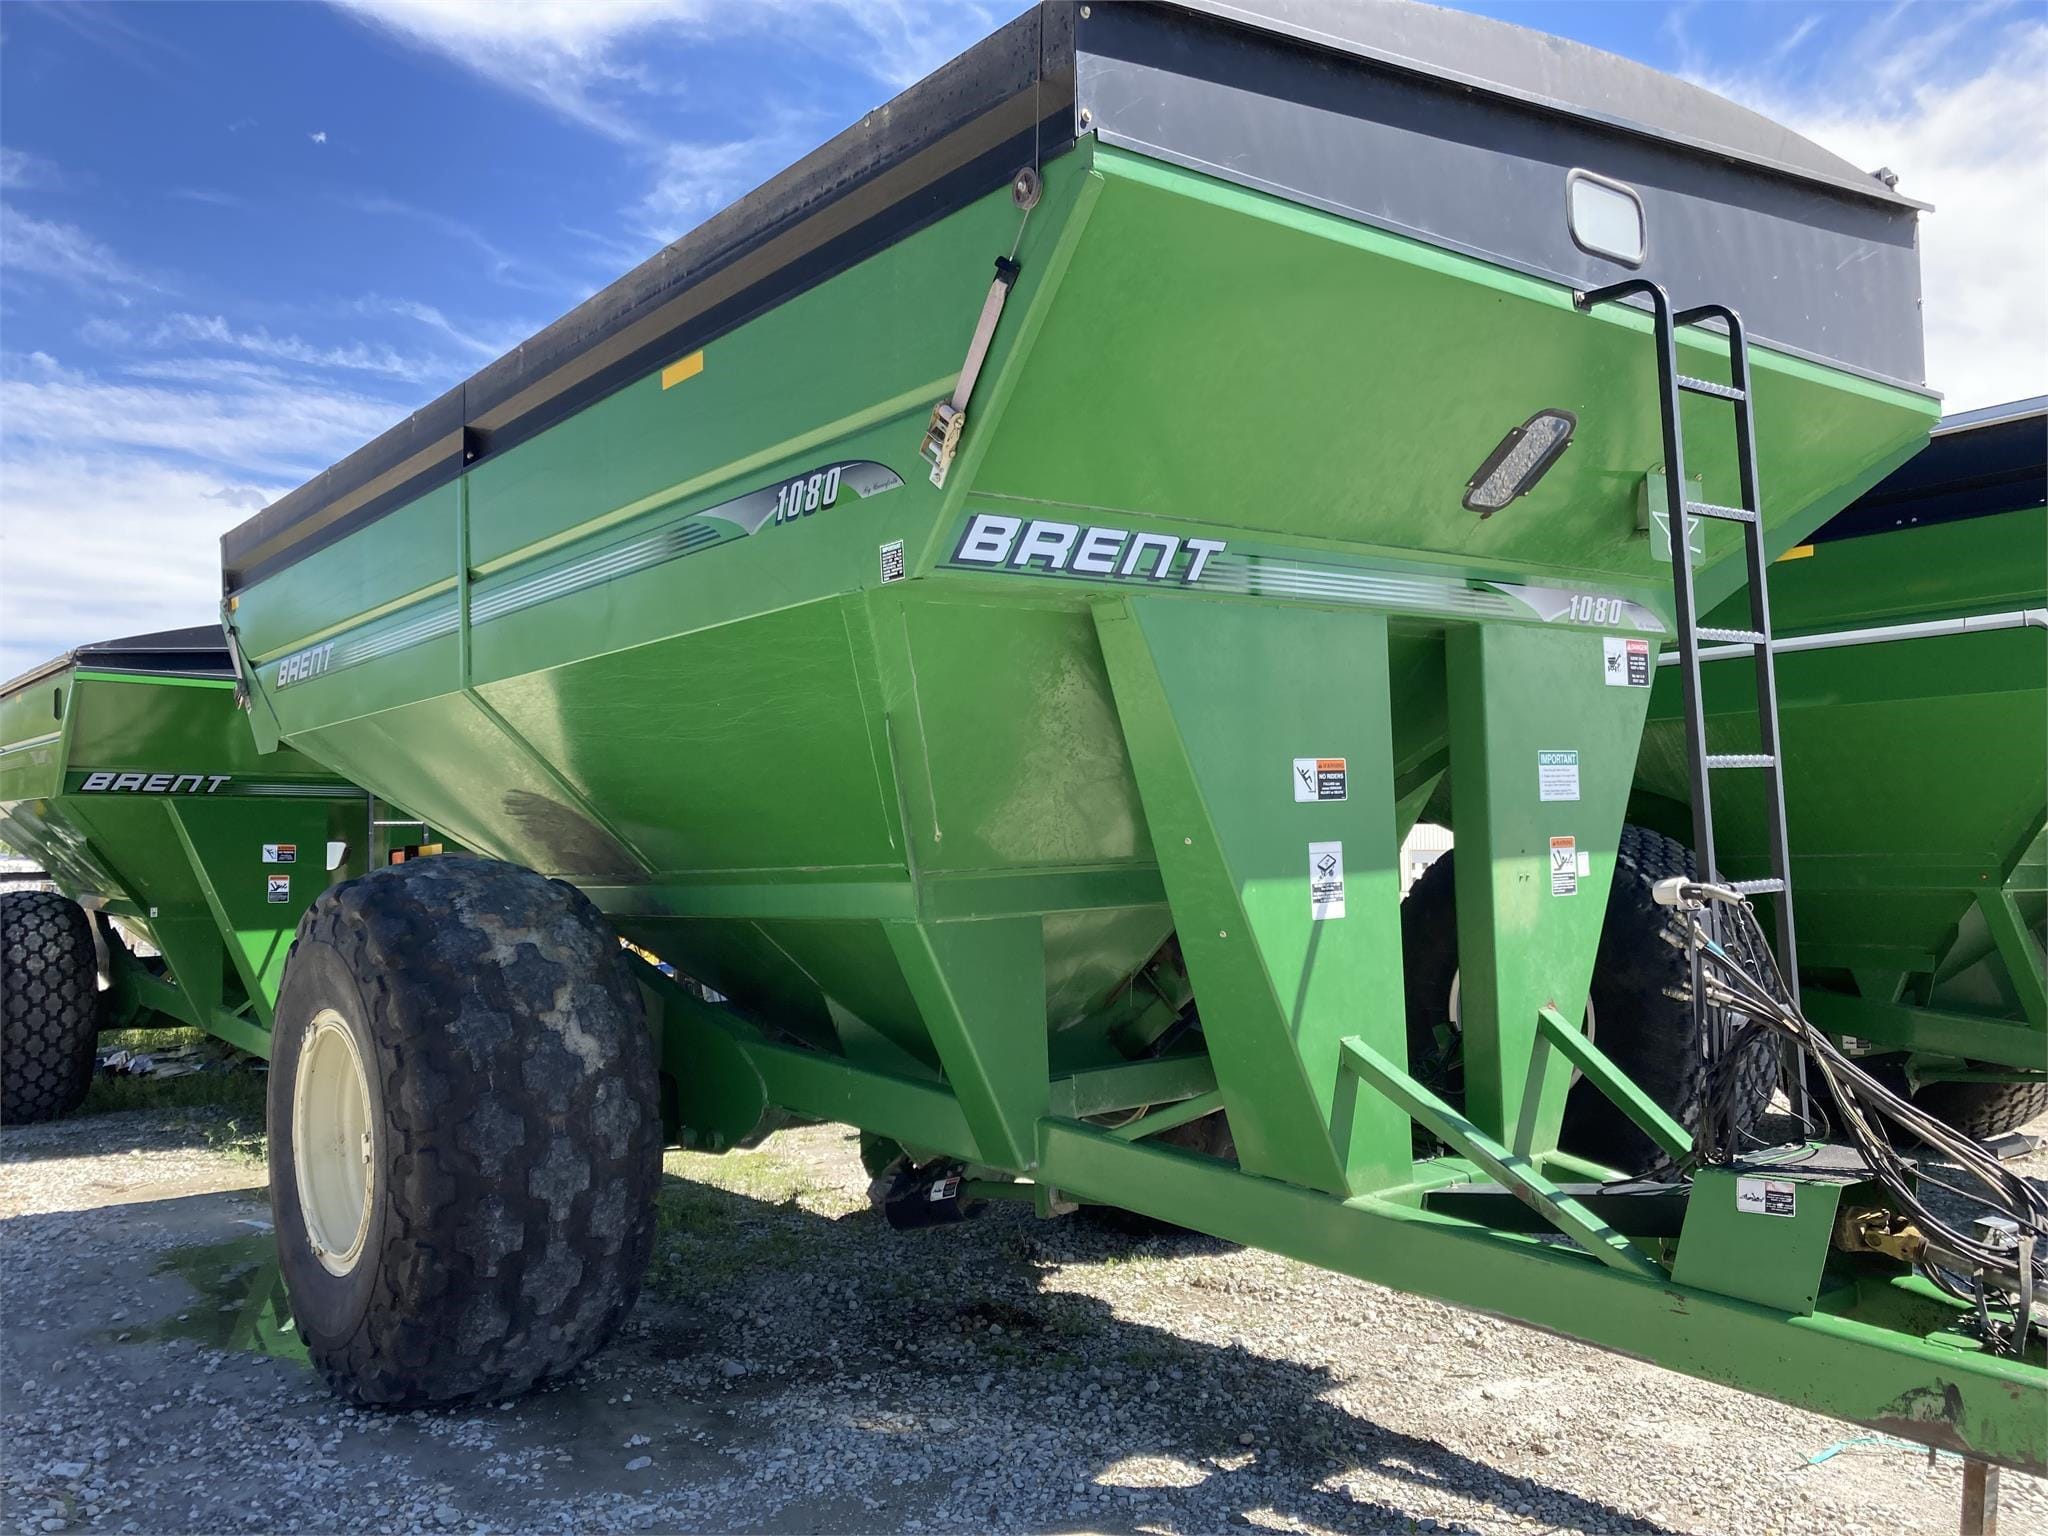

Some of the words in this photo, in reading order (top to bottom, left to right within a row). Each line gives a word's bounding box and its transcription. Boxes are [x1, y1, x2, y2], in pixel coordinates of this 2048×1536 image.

[776, 467, 841, 523] 1080
[955, 513, 1227, 582] BRENT
[1569, 594, 1623, 625] 1080
[277, 643, 334, 687] BRENT
[1540, 753, 1576, 765] IMPORTANT
[81, 772, 233, 794] BRENT
